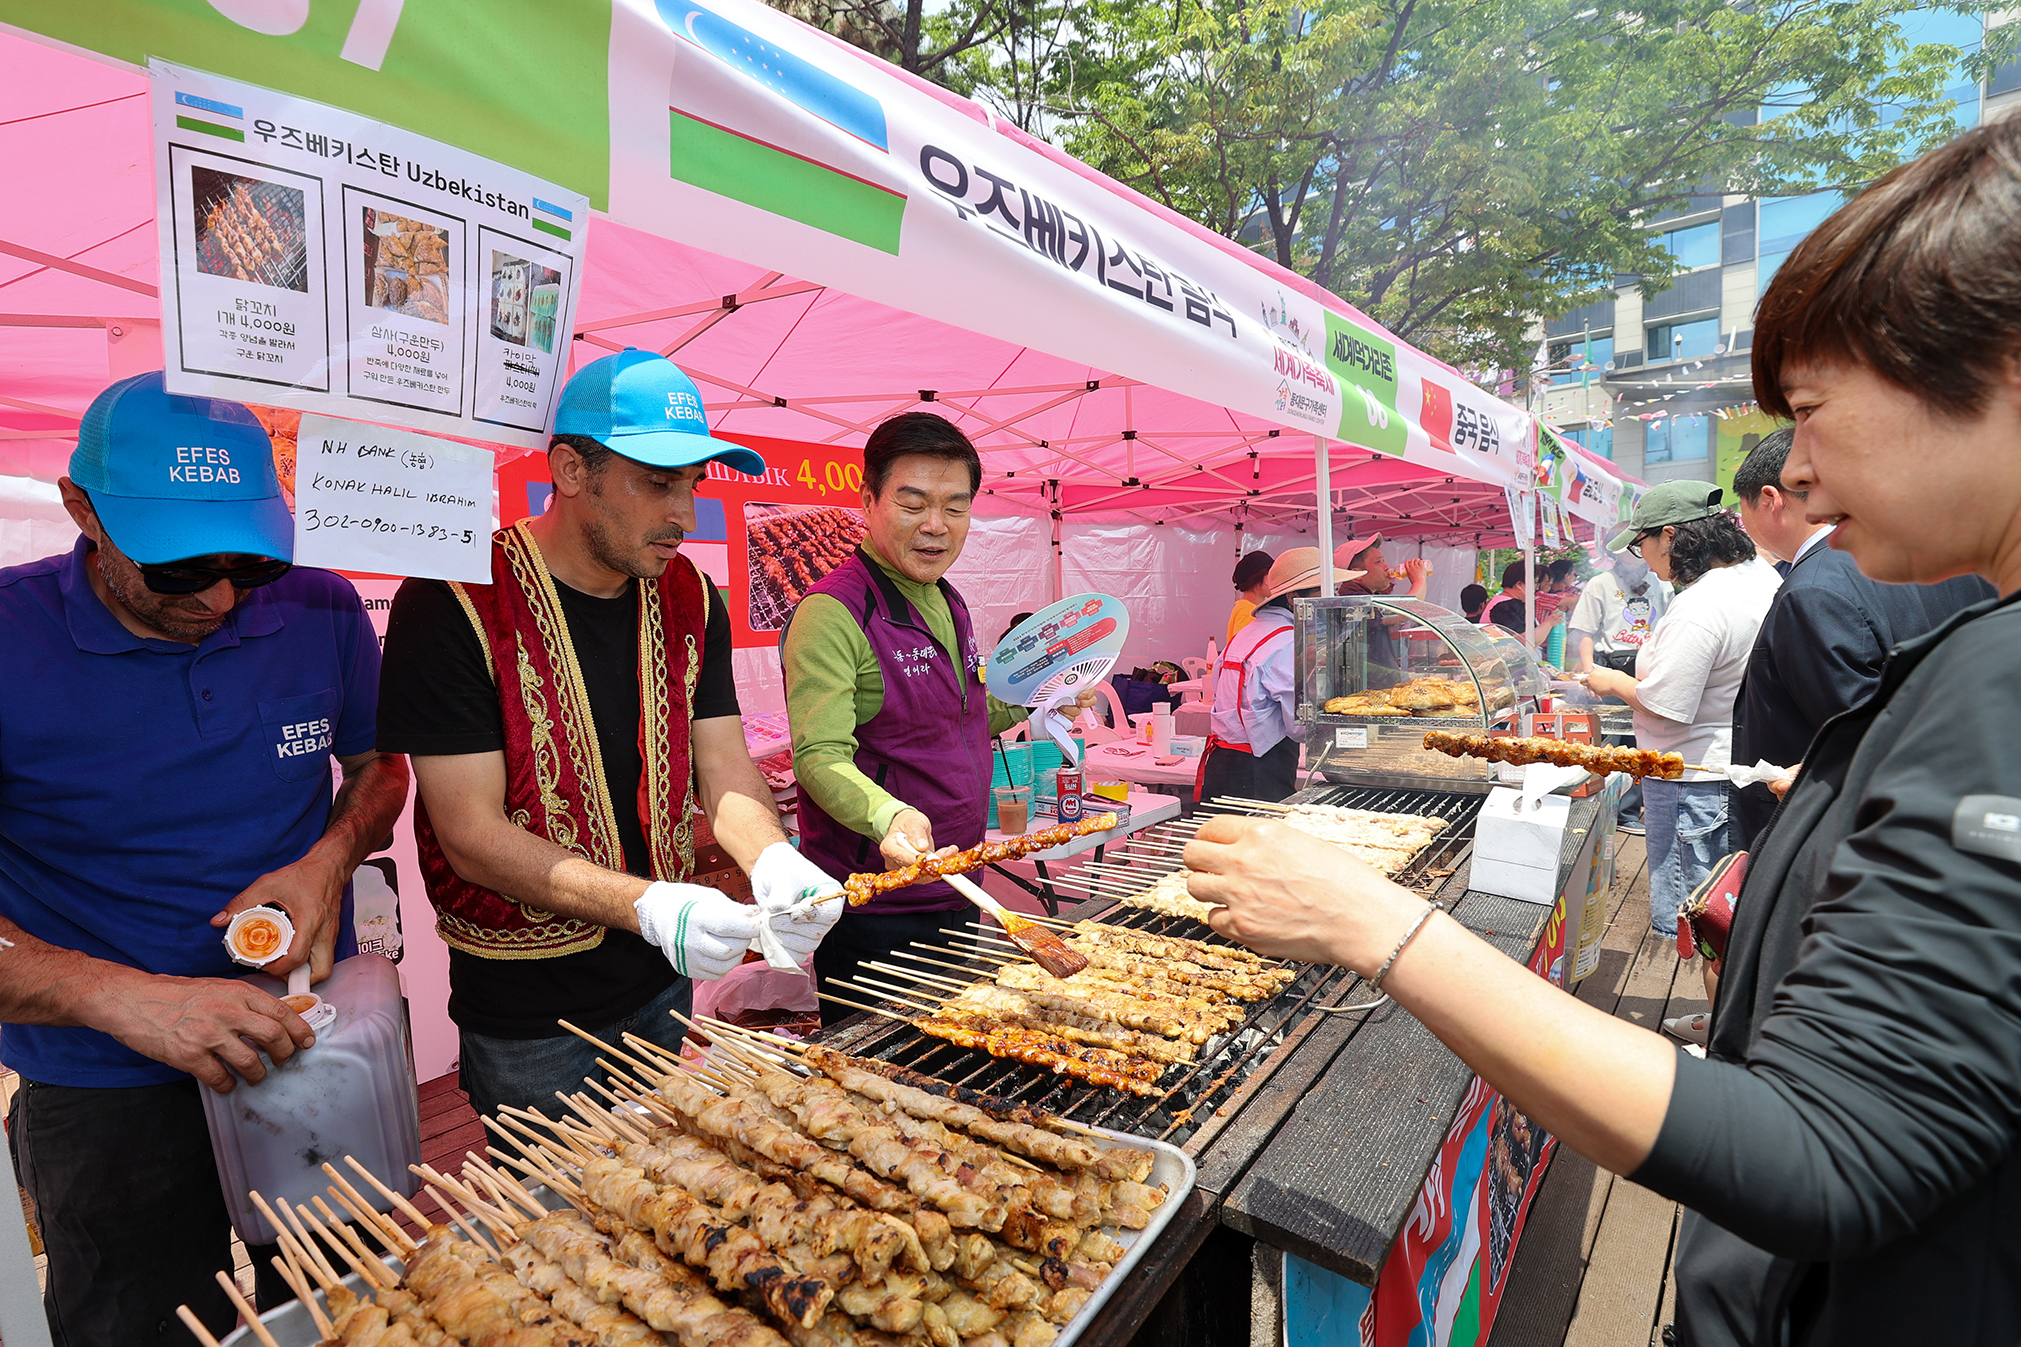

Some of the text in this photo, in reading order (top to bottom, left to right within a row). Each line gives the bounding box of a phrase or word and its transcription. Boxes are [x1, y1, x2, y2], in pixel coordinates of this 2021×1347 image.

[253, 118, 529, 220] 우즈베키스탄 Uzbekistan
[919, 144, 1238, 339] 우즈베키스탄 음식
[235, 298, 276, 317] 닭꼬치
[217, 310, 295, 336] 1개 4,000원
[219, 329, 295, 350] 각종 양념을 발라서
[371, 325, 445, 352] 삼사(구운만두)
[236, 348, 283, 363] 구운 닭꼬치
[366, 356, 389, 368] 반죽에
[390, 362, 412, 373] 다양한
[503, 348, 537, 365] 카이막
[1333, 330, 1393, 382] 세계먹거리존
[1273, 345, 1335, 396] 세계가족축제
[396, 378, 436, 392] 우즈베키스탄
[667, 392, 699, 409] EFES
[1290, 392, 1328, 418] 동대문구가족센터
[664, 406, 705, 424] KEBAB
[1454, 403, 1500, 455] 중국 음식
[176, 447, 231, 465] EFES
[321, 440, 348, 454] NH
[357, 445, 396, 458] BANK
[169, 466, 241, 484] KEBAB
[311, 472, 367, 492] KONAK
[371, 483, 418, 499] HALIL
[796, 459, 863, 497] 4,00
[1612, 629, 1644, 650] Betty
[281, 718, 330, 740] EFES
[276, 732, 333, 759] KEBAB
[358, 938, 384, 955] 이크
